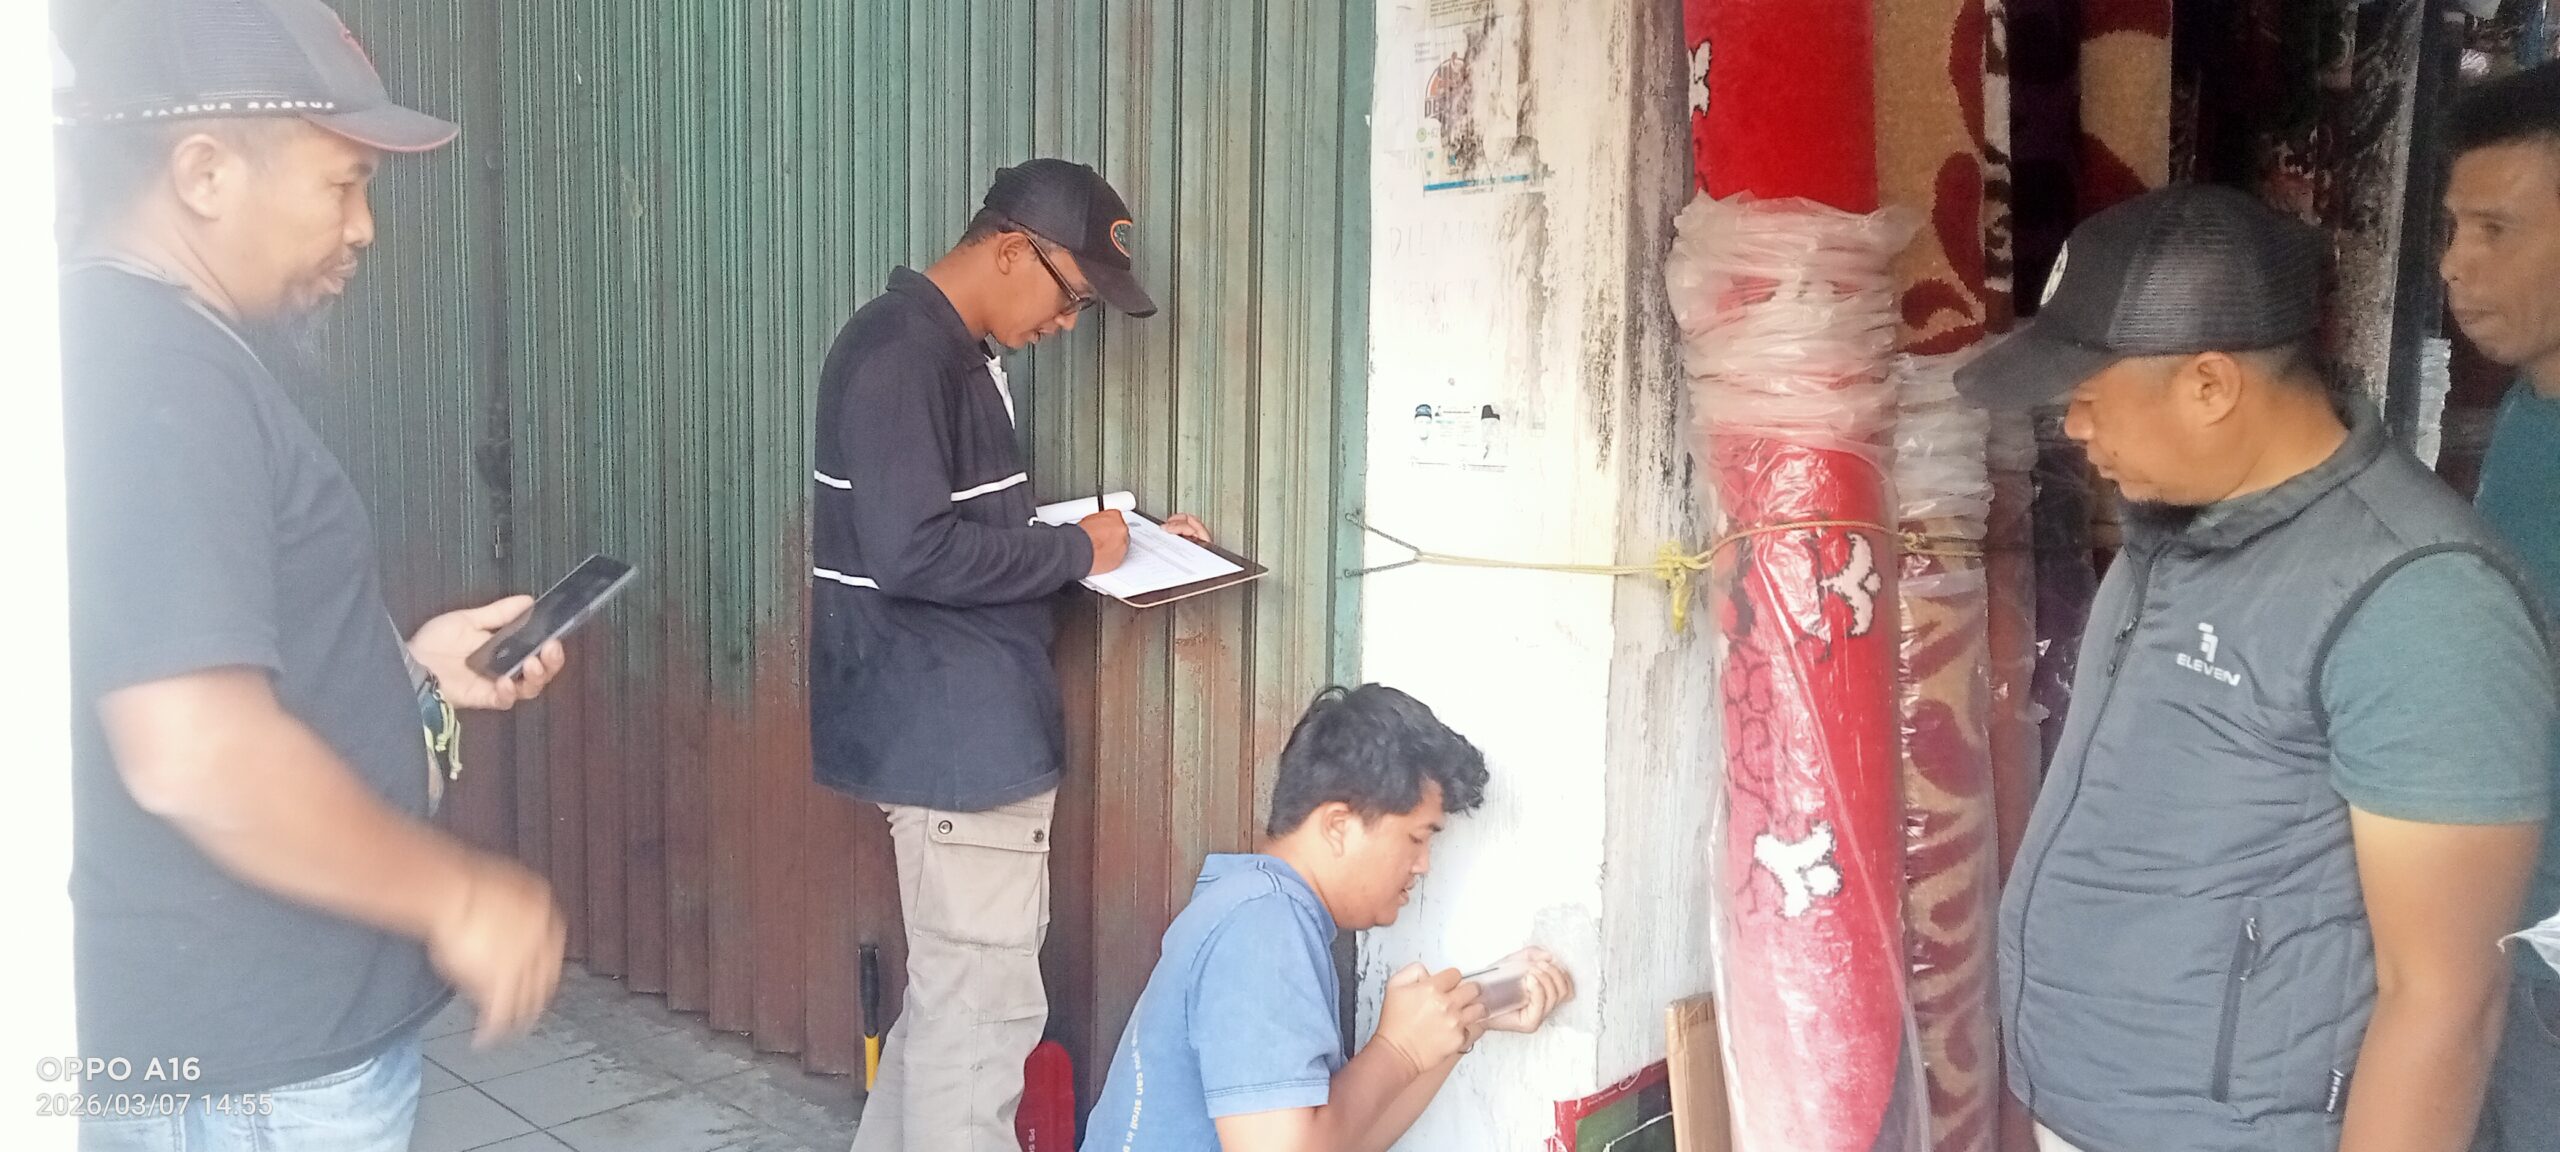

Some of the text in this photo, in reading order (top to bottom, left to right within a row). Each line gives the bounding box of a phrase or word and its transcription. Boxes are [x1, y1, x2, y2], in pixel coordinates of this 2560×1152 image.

[2176, 652, 2241, 687] ELEVEN
[1136, 1071, 1144, 1095] can
[1130, 1099, 1143, 1130] stroll
